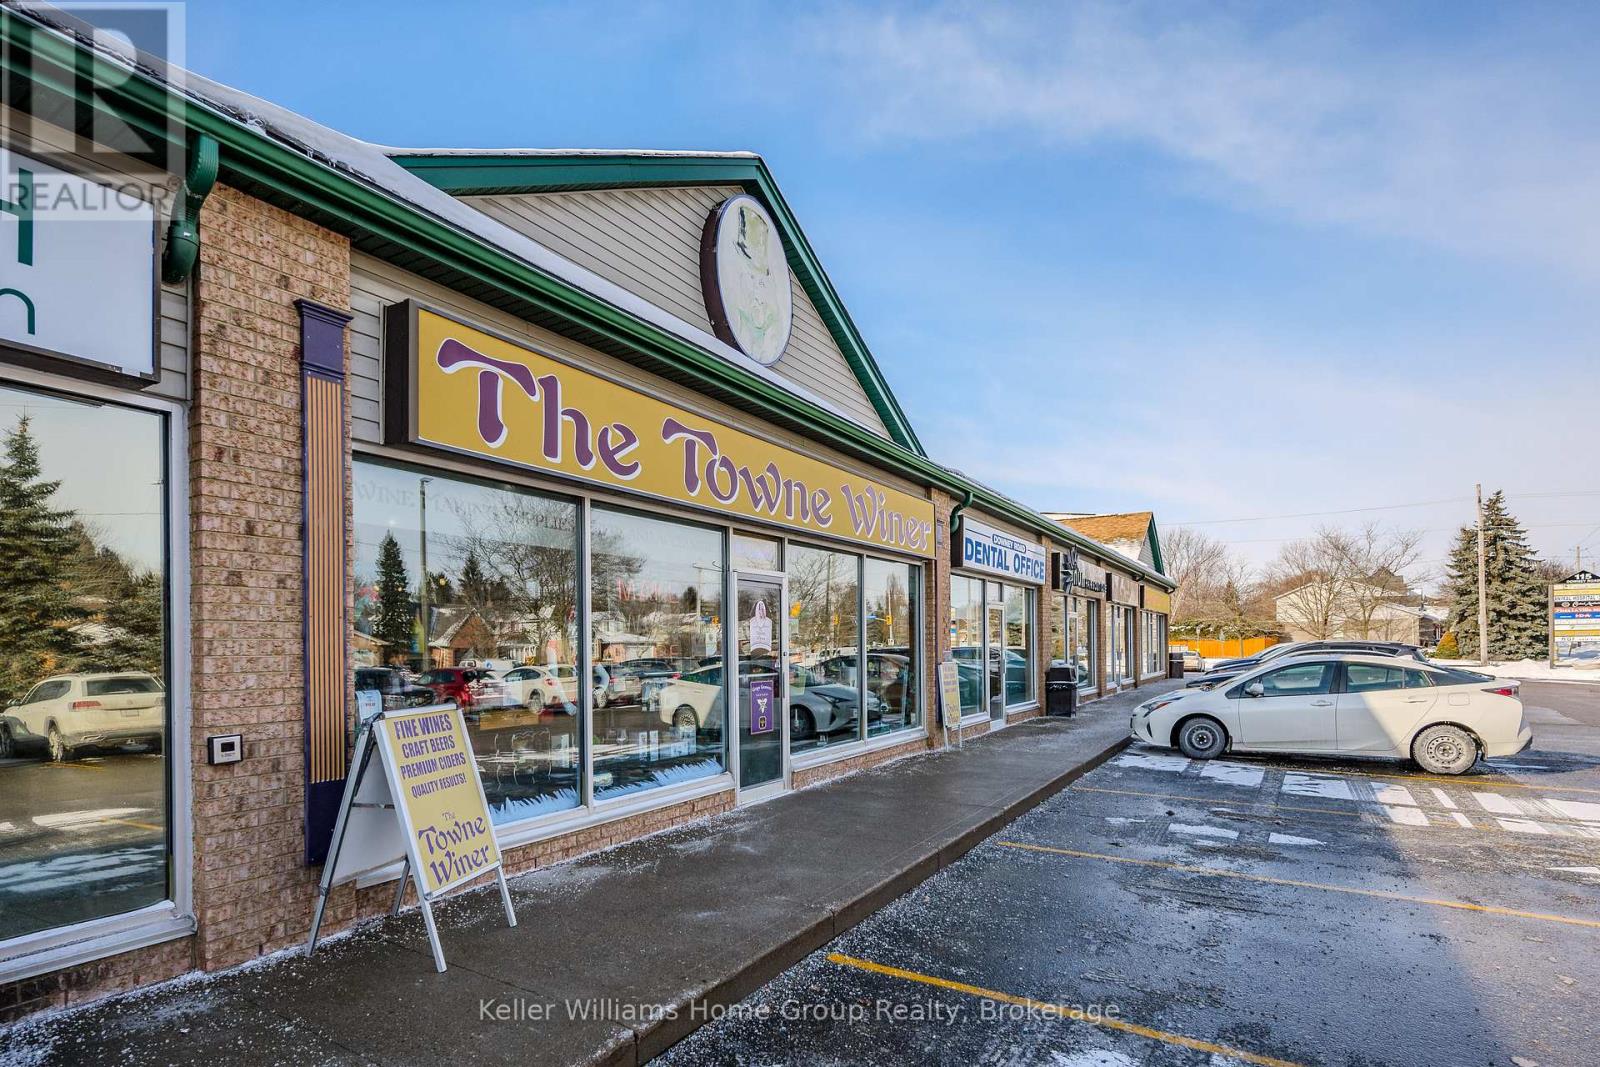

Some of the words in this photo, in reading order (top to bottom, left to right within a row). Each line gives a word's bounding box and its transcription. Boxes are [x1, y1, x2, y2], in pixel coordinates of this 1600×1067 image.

[436, 337, 641, 481] The
[660, 416, 833, 528] Towne
[839, 483, 931, 550] Winer
[965, 537, 1009, 571] DENTAL
[1014, 553, 1044, 580] OFFICE
[394, 718, 419, 740] FINE
[417, 713, 453, 735] WINES
[401, 740, 430, 759] CRAFT
[430, 735, 455, 753] BEERS
[400, 758, 438, 780] PREMIUM
[438, 752, 467, 770] CIDERS
[411, 780, 439, 799] QUALITY
[439, 772, 467, 790] RESULTS!
[418, 816, 486, 856] Towne
[430, 844, 489, 886] Winer
